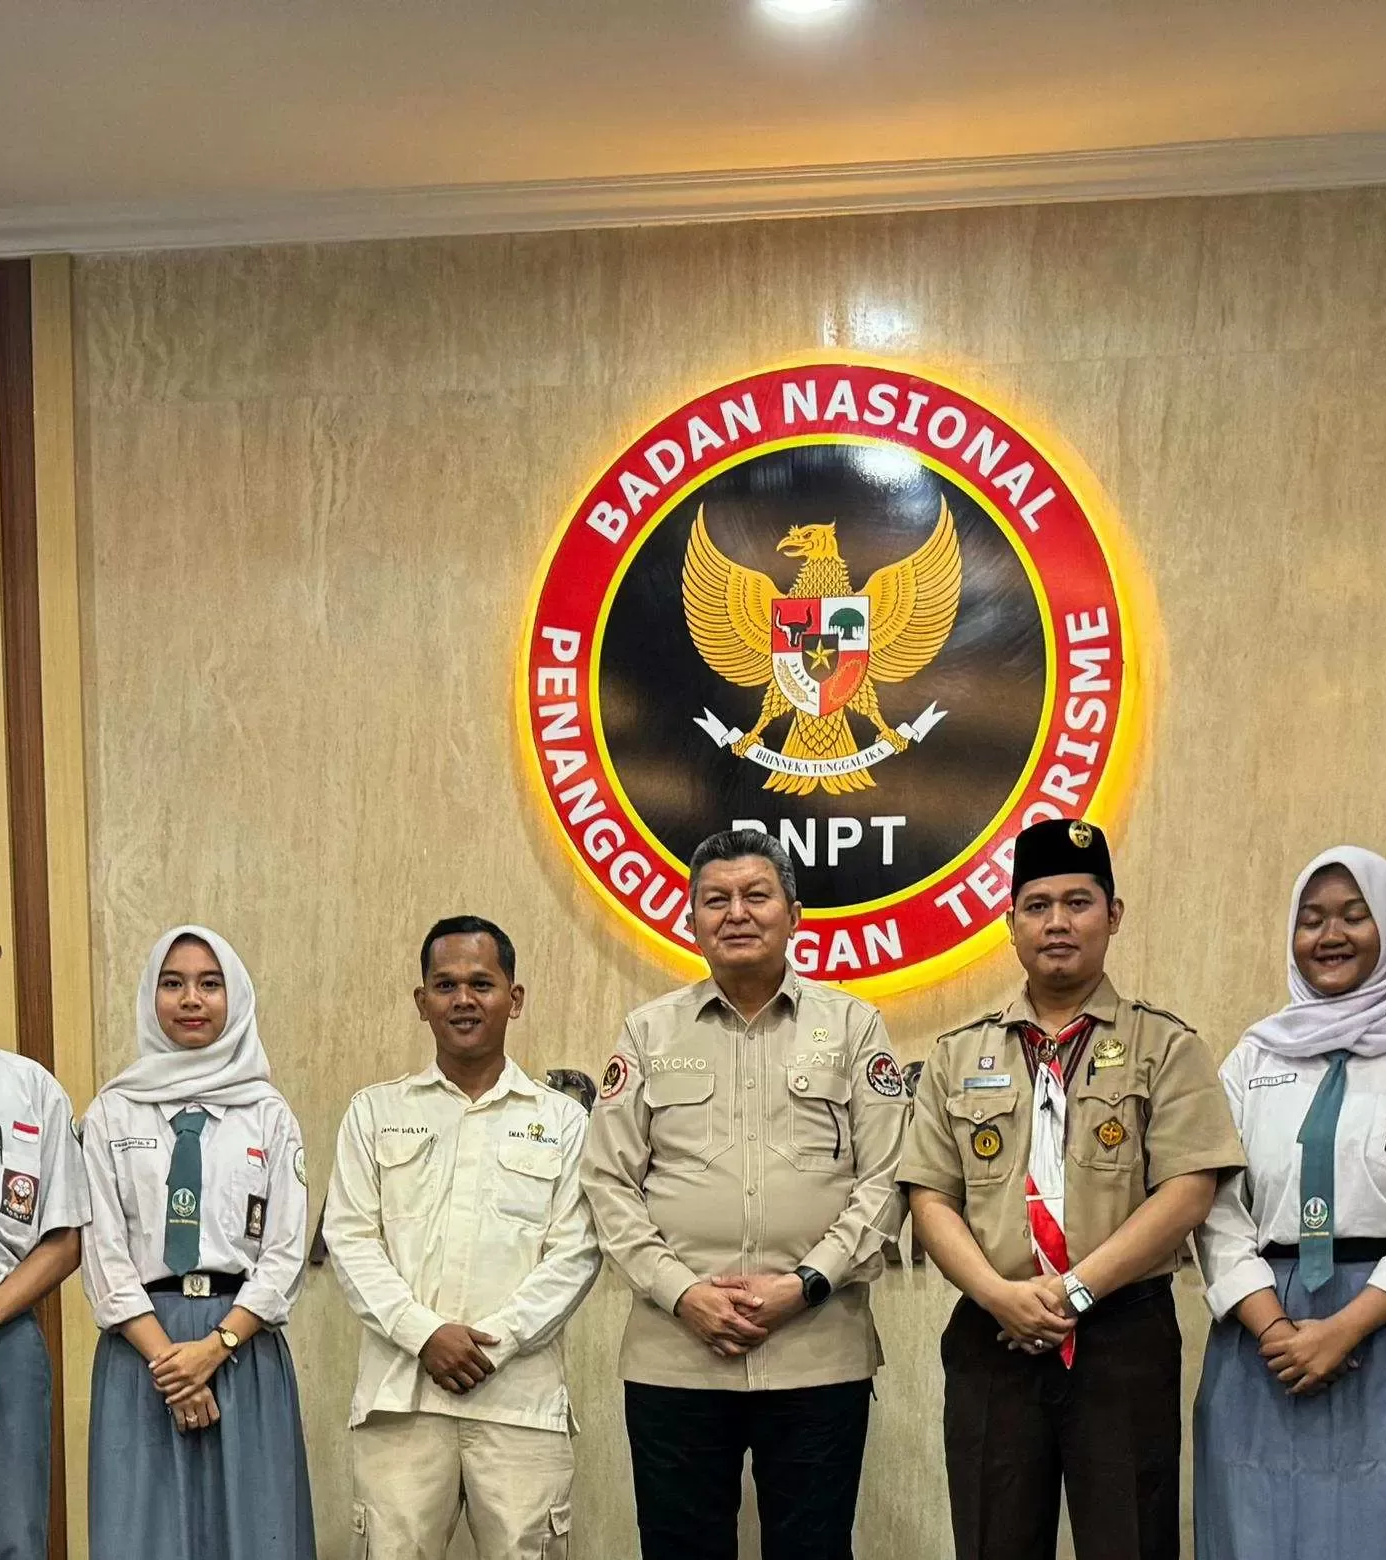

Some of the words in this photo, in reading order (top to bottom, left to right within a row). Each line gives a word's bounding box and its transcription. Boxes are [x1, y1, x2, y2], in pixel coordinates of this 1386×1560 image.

[586, 392, 760, 544] BADAN
[782, 379, 1057, 534] NASIONAL
[755, 750, 809, 773] BHINNEKA
[813, 760, 864, 774] TUNGGAL
[865, 747, 885, 762] IKA
[537, 626, 903, 973] PENANGGULGAN
[732, 815, 907, 867] NPT
[650, 1056, 707, 1072] RYCKO
